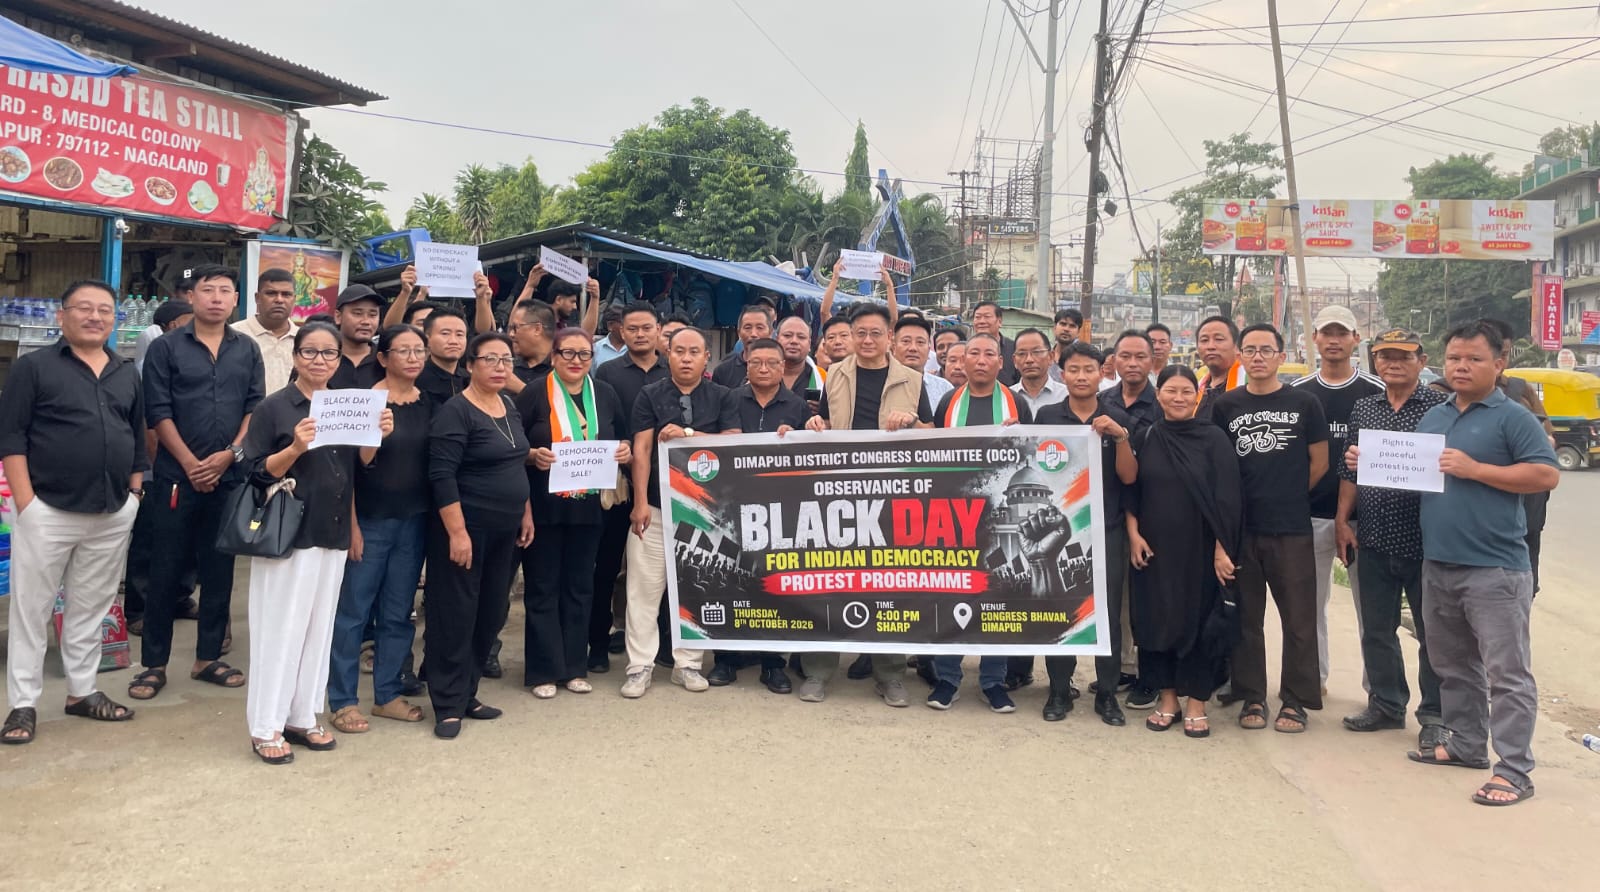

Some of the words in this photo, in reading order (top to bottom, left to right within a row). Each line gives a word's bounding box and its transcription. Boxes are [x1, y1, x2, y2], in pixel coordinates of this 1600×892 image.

[0, 64, 111, 107] RASAD
[121, 80, 168, 122] TEA
[177, 96, 243, 141] STALL
[42, 104, 57, 124] 8,
[61, 108, 137, 140] MEDICAL
[141, 126, 201, 153] COLONY
[0, 121, 42, 145] PUR
[56, 132, 110, 157] 797112
[124, 145, 209, 176] NAGALAND
[1000, 225, 1029, 233] SISTERS
[432, 248, 468, 256] DEMOCRACY
[1548, 285, 1557, 340] JALMAHAL
[323, 397, 350, 405] BLACK
[352, 396, 371, 405] DAY
[320, 411, 336, 419] FOR
[337, 409, 369, 418] INDIAN
[1253, 410, 1300, 424] CYCLES
[314, 423, 370, 433] DEMOCRACY!
[1382, 438, 1403, 447] Right
[559, 447, 608, 456] DEMOCRACY
[1379, 451, 1416, 460] peaceful
[570, 459, 585, 467] NOT
[733, 455, 791, 469] DIMAPUR
[794, 452, 849, 467] DISTRICT
[851, 450, 912, 465] CONGRESS
[914, 449, 982, 463] COMMITTEE
[986, 448, 1020, 464] (DCC)
[1370, 462, 1400, 470] protest
[1401, 463, 1409, 471] is
[813, 479, 910, 496] OBSERVANCE
[914, 478, 933, 494] OF
[740, 498, 888, 552] BLACK
[891, 498, 986, 548] DAY
[765, 552, 800, 571] FOR
[804, 550, 866, 569] INDIAN
[871, 549, 980, 567] DEMOCRACY
[780, 572, 856, 592] PROTEST
[861, 571, 972, 589] PROGRAMME
[733, 600, 751, 608] DATE
[875, 601, 895, 609] TIME
[980, 602, 1006, 611] VENUE
[733, 608, 781, 619] THURSDAY,
[876, 610, 900, 621] 4:00
[902, 610, 920, 622] PM
[980, 611, 1028, 622] CONGRESS
[1030, 612, 1070, 623] BHAVAN,
[734, 619, 747, 629] 8TH
[749, 619, 788, 629] OCTOBER
[790, 620, 814, 630] 2026
[876, 621, 911, 632] SHARP
[981, 622, 1023, 632] DIMAPUR
